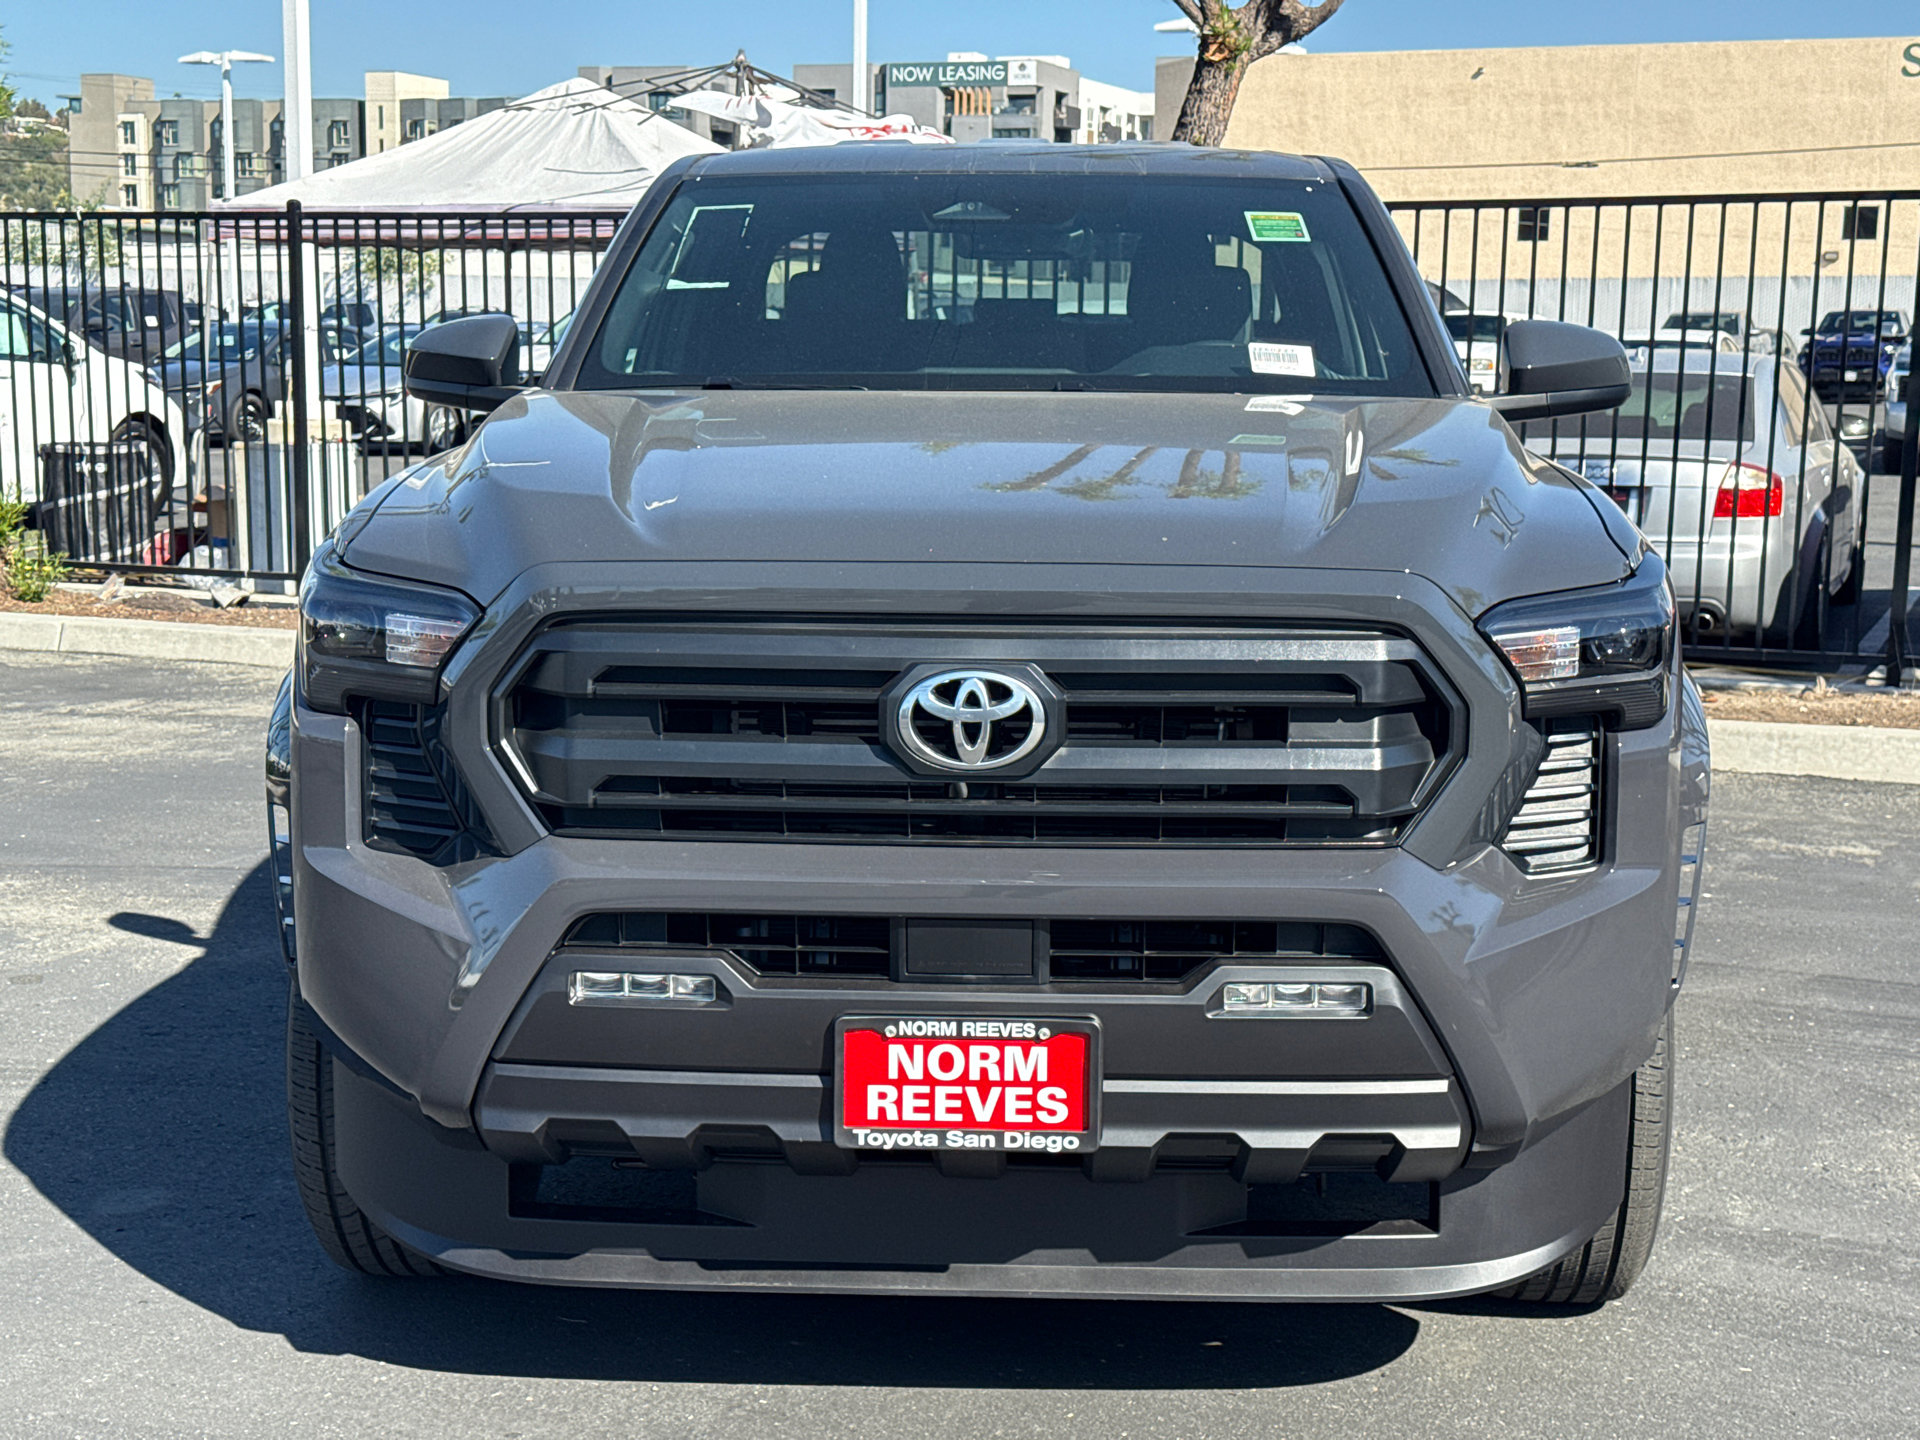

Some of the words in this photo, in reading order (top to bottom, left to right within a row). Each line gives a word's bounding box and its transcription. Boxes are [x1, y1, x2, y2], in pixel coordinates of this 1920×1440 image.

[892, 66, 934, 82] NOW
[938, 64, 1006, 81] LEASING
[898, 1021, 957, 1037] NORM
[962, 1022, 1036, 1038] REEVES
[888, 1044, 1048, 1082] NORM
[866, 1084, 1069, 1124] REEVES
[852, 1129, 938, 1150] Toyota
[945, 1131, 996, 1149] San
[1003, 1131, 1080, 1152] Diego
